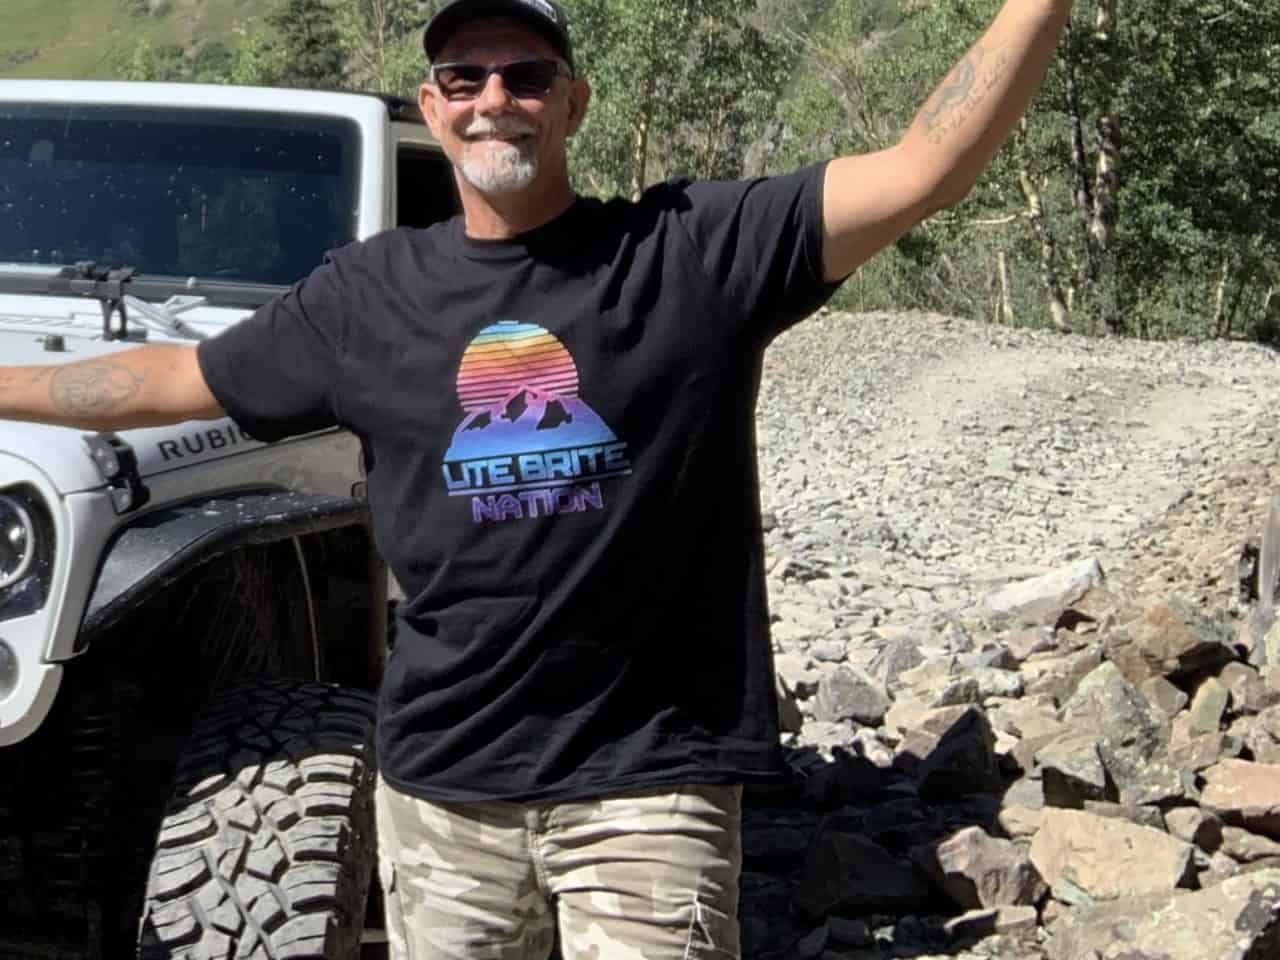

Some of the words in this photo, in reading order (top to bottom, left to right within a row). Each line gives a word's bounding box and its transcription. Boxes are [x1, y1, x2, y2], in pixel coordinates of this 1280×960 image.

[442, 456, 515, 490] LITE
[518, 442, 631, 482] BRITE
[471, 482, 604, 523] NATION
